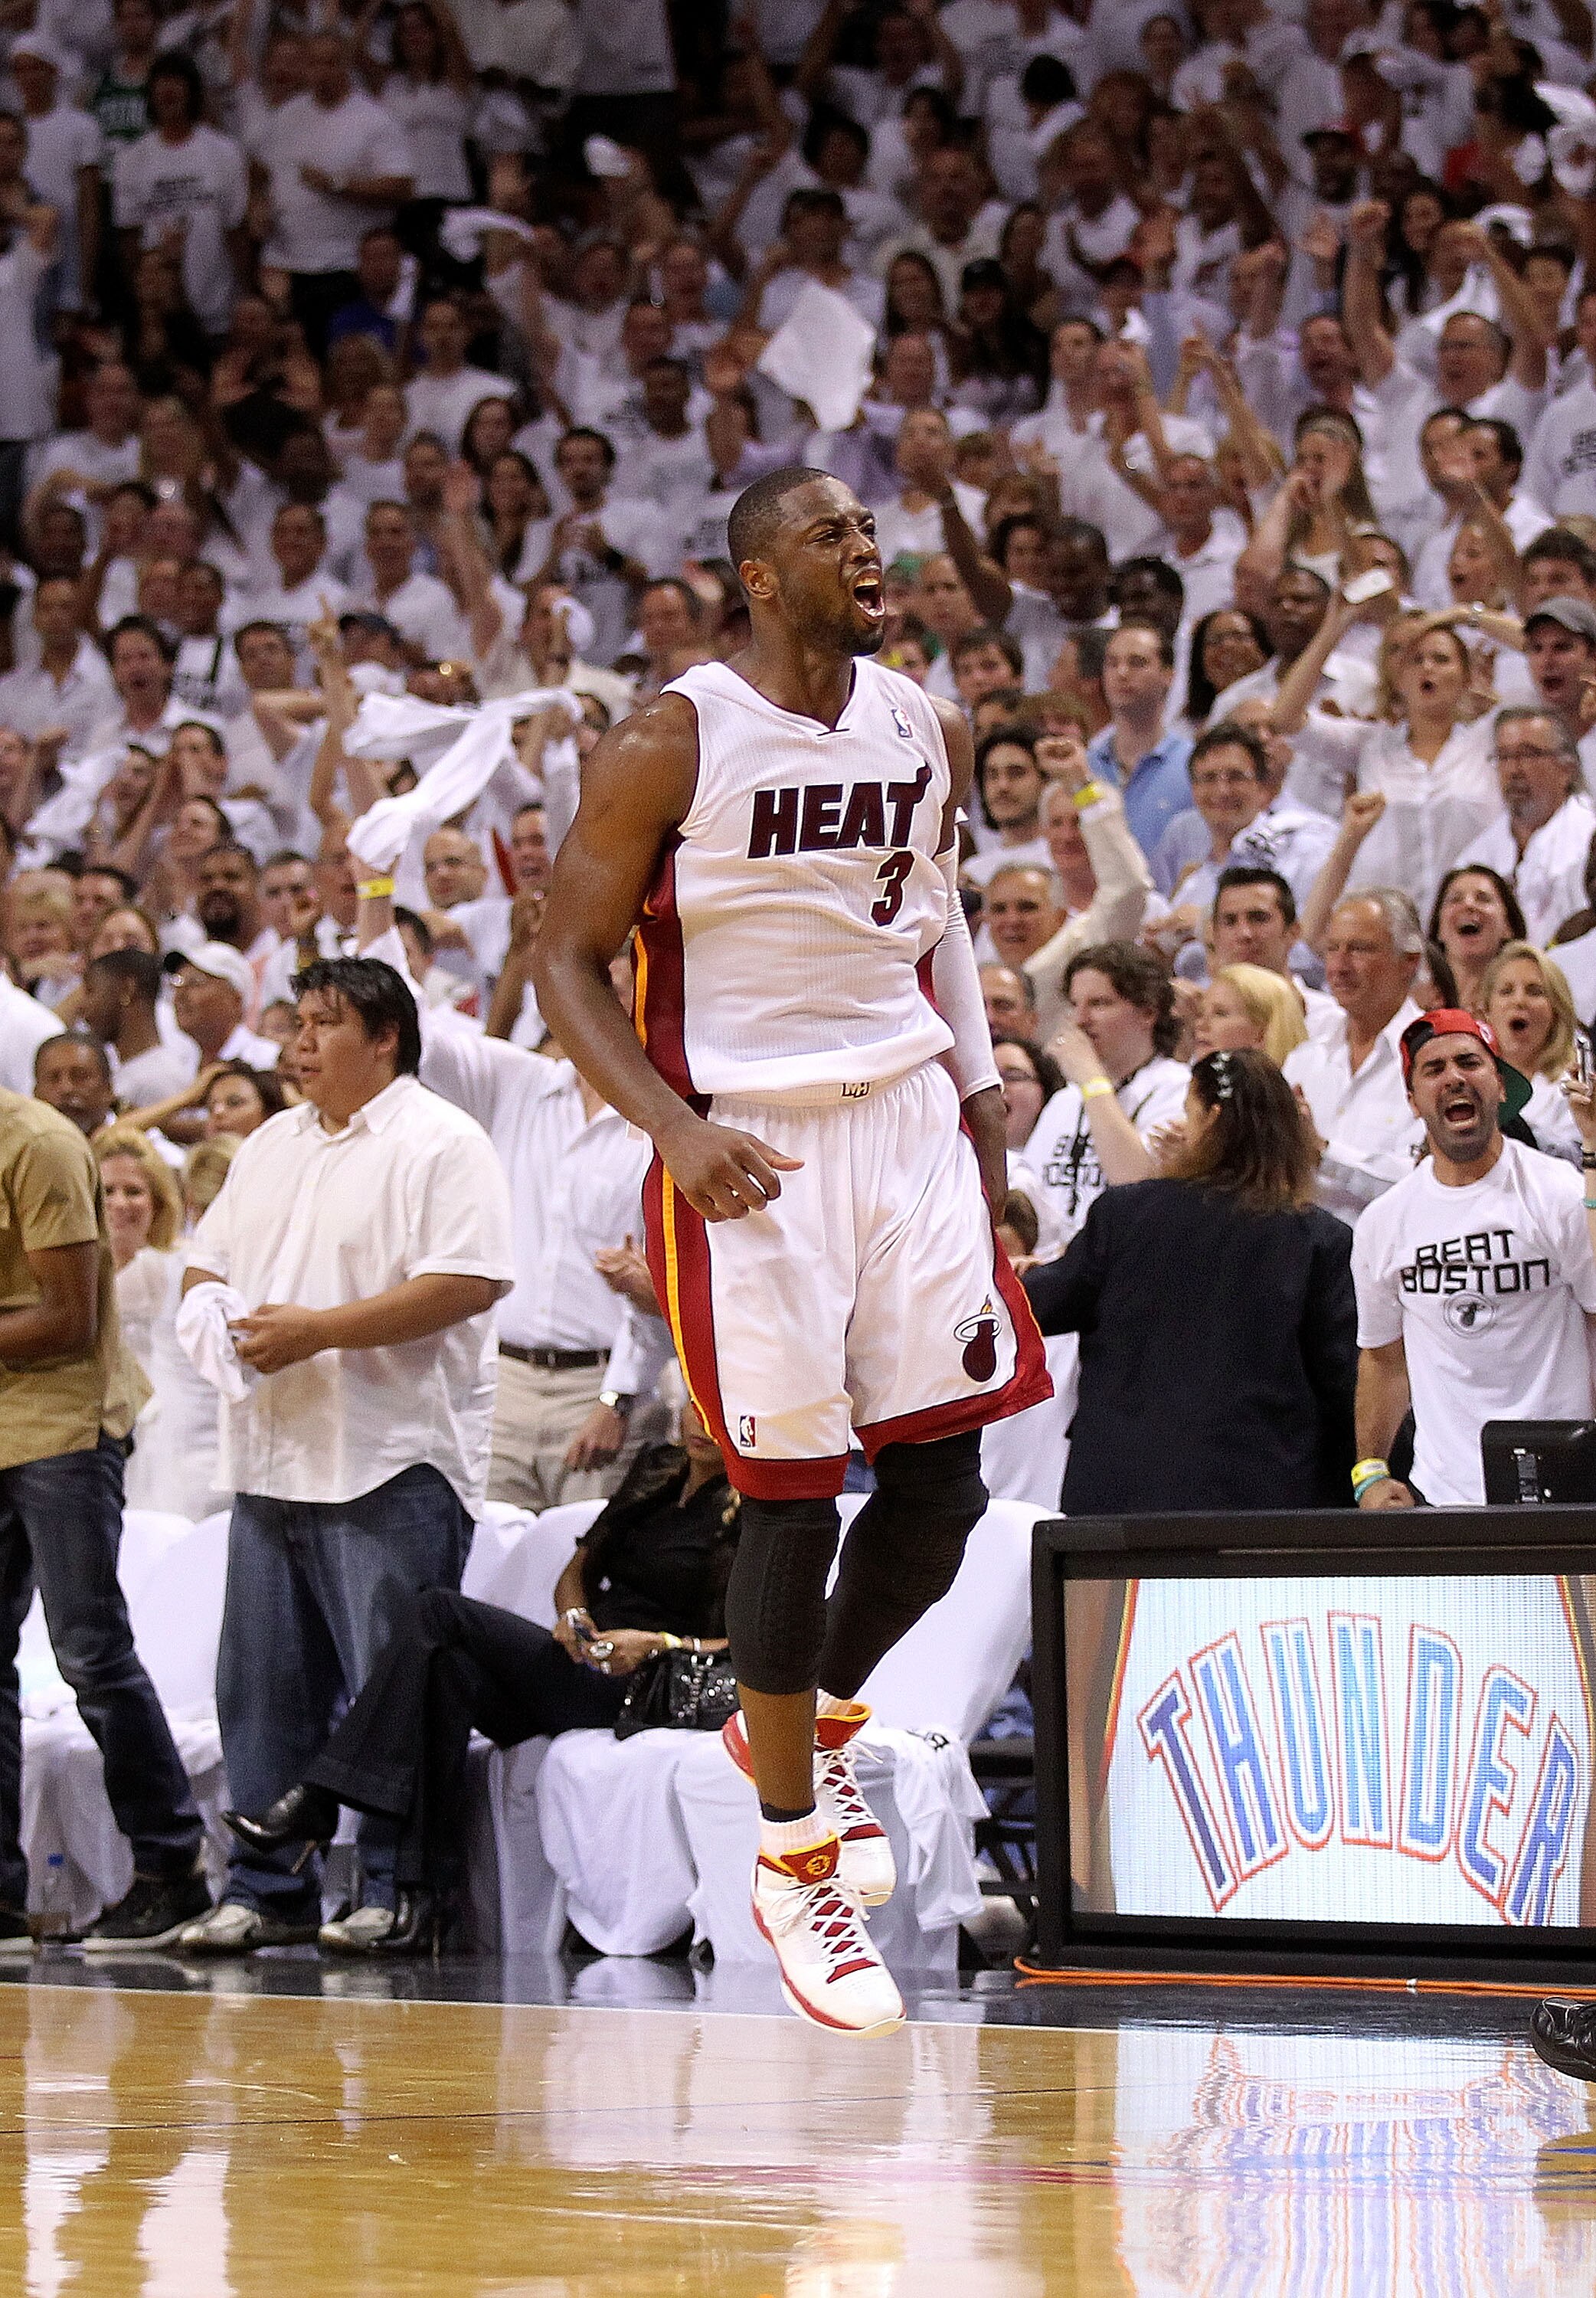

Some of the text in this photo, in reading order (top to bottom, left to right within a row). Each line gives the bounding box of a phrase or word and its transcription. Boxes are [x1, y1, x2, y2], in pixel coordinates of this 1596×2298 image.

[747, 761, 932, 859] HEAT
[871, 850, 915, 927] 3
[1401, 1259, 1550, 1294] BOSTON
[1415, 1230, 1513, 1265] BEAT
[1138, 1609, 1579, 1926] THUNDER
